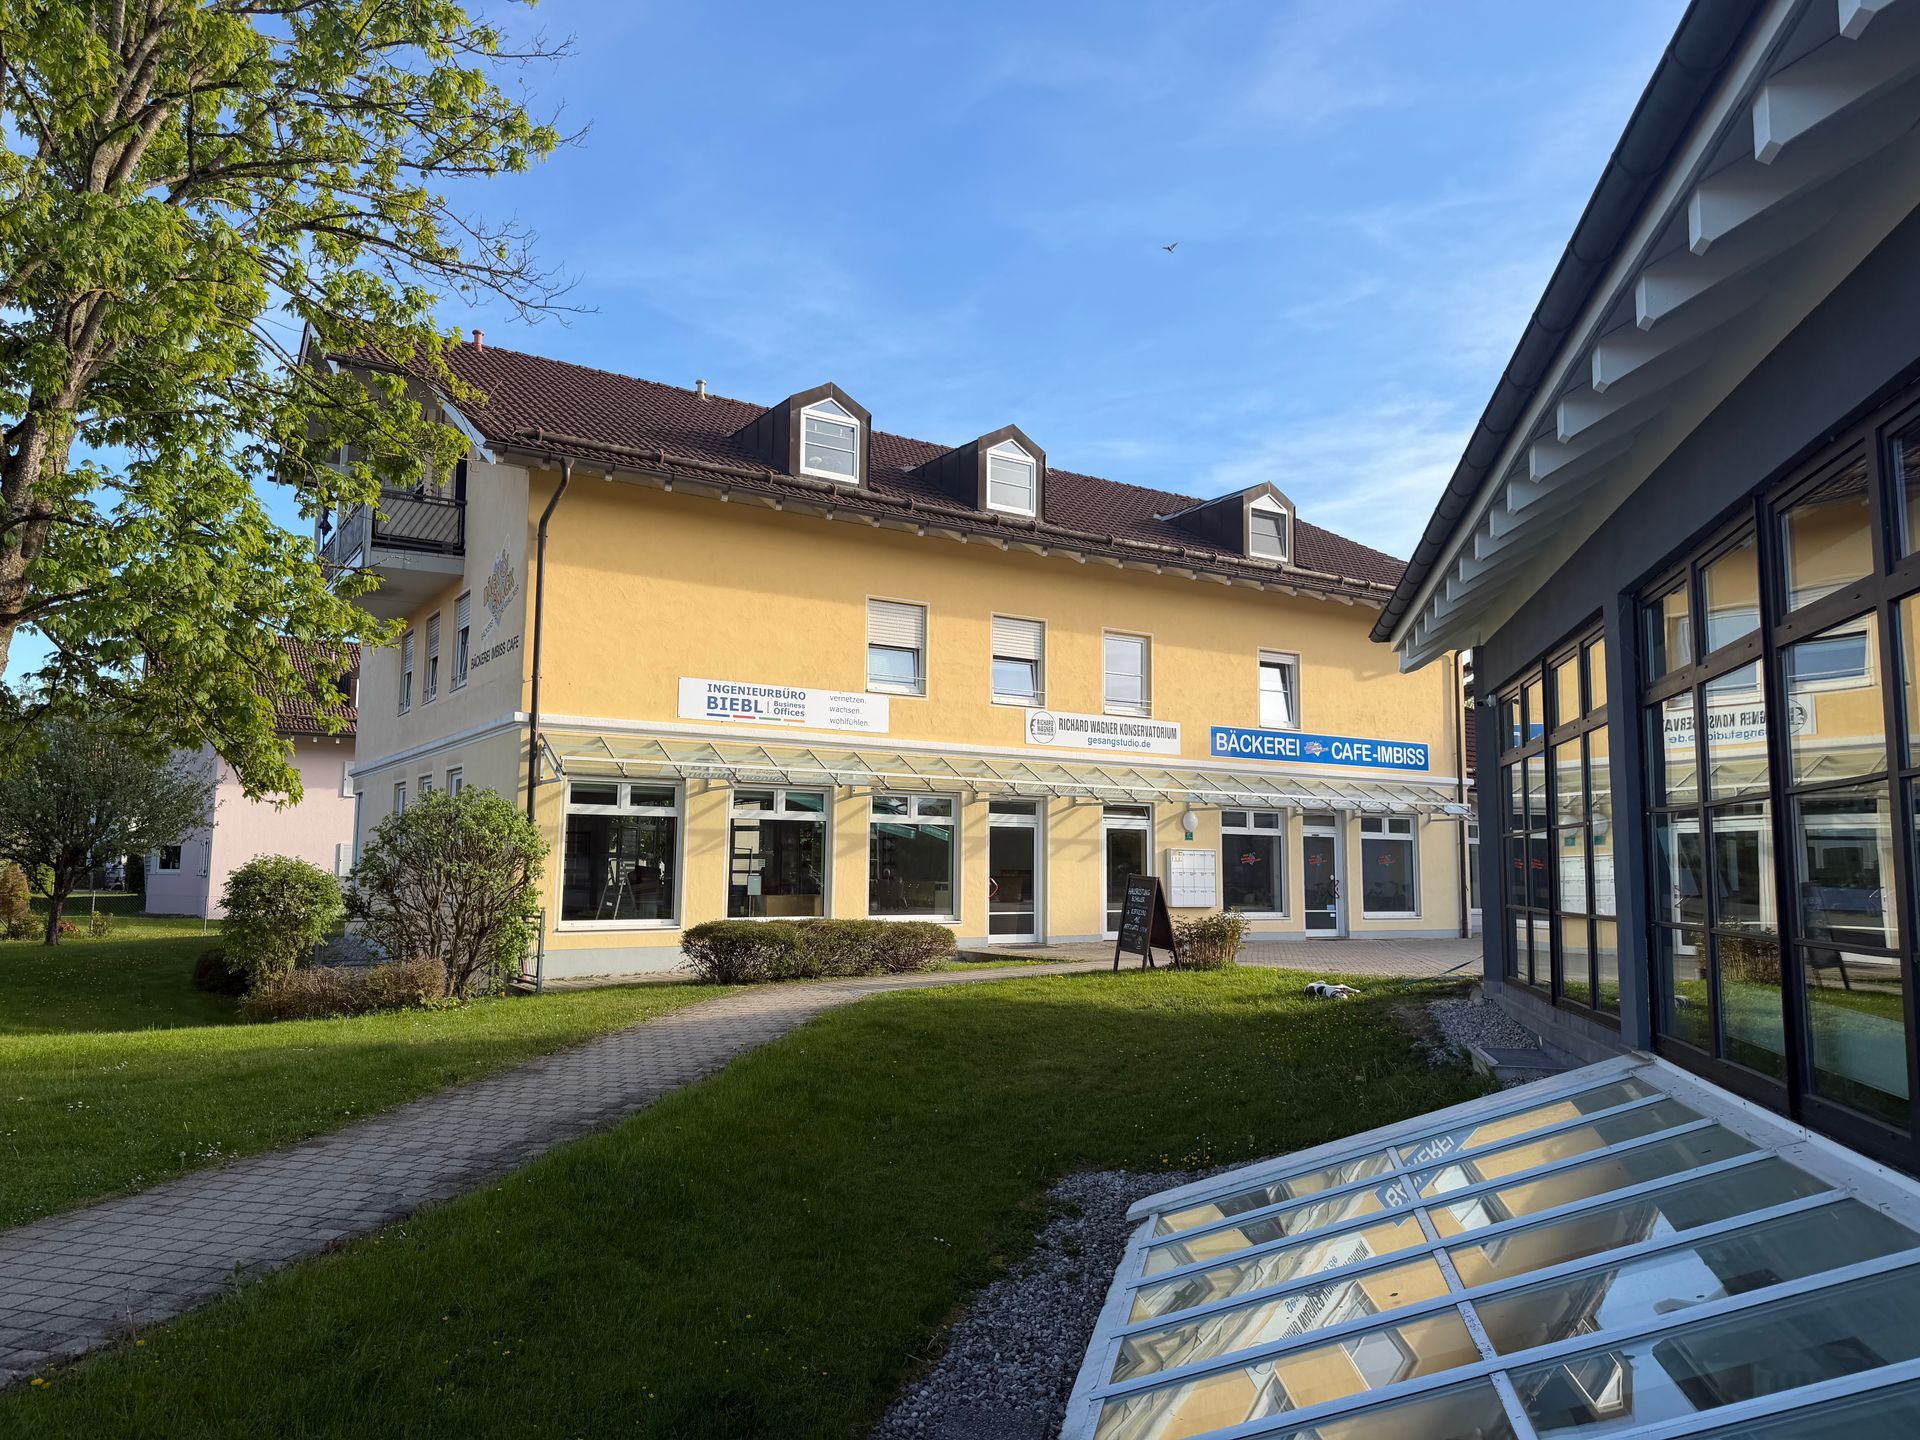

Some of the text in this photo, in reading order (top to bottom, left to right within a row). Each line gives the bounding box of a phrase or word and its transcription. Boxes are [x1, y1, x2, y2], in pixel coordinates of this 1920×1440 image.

[506, 635, 519, 653] CAFE
[707, 683, 806, 701] INGENIEURBÜRO
[706, 696, 763, 713] BIEBL
[773, 700, 806, 709] Business
[773, 708, 805, 717] Offices
[829, 716, 870, 727] wohlfühlen.
[1058, 717, 1177, 740] RICHARD WAGNER KONSERVATORIUM
[1087, 736, 1151, 748] gesangstudio.de
[1216, 730, 1300, 757] BÄCKEREI
[1331, 742, 1425, 766] CAFE-IMBISS
